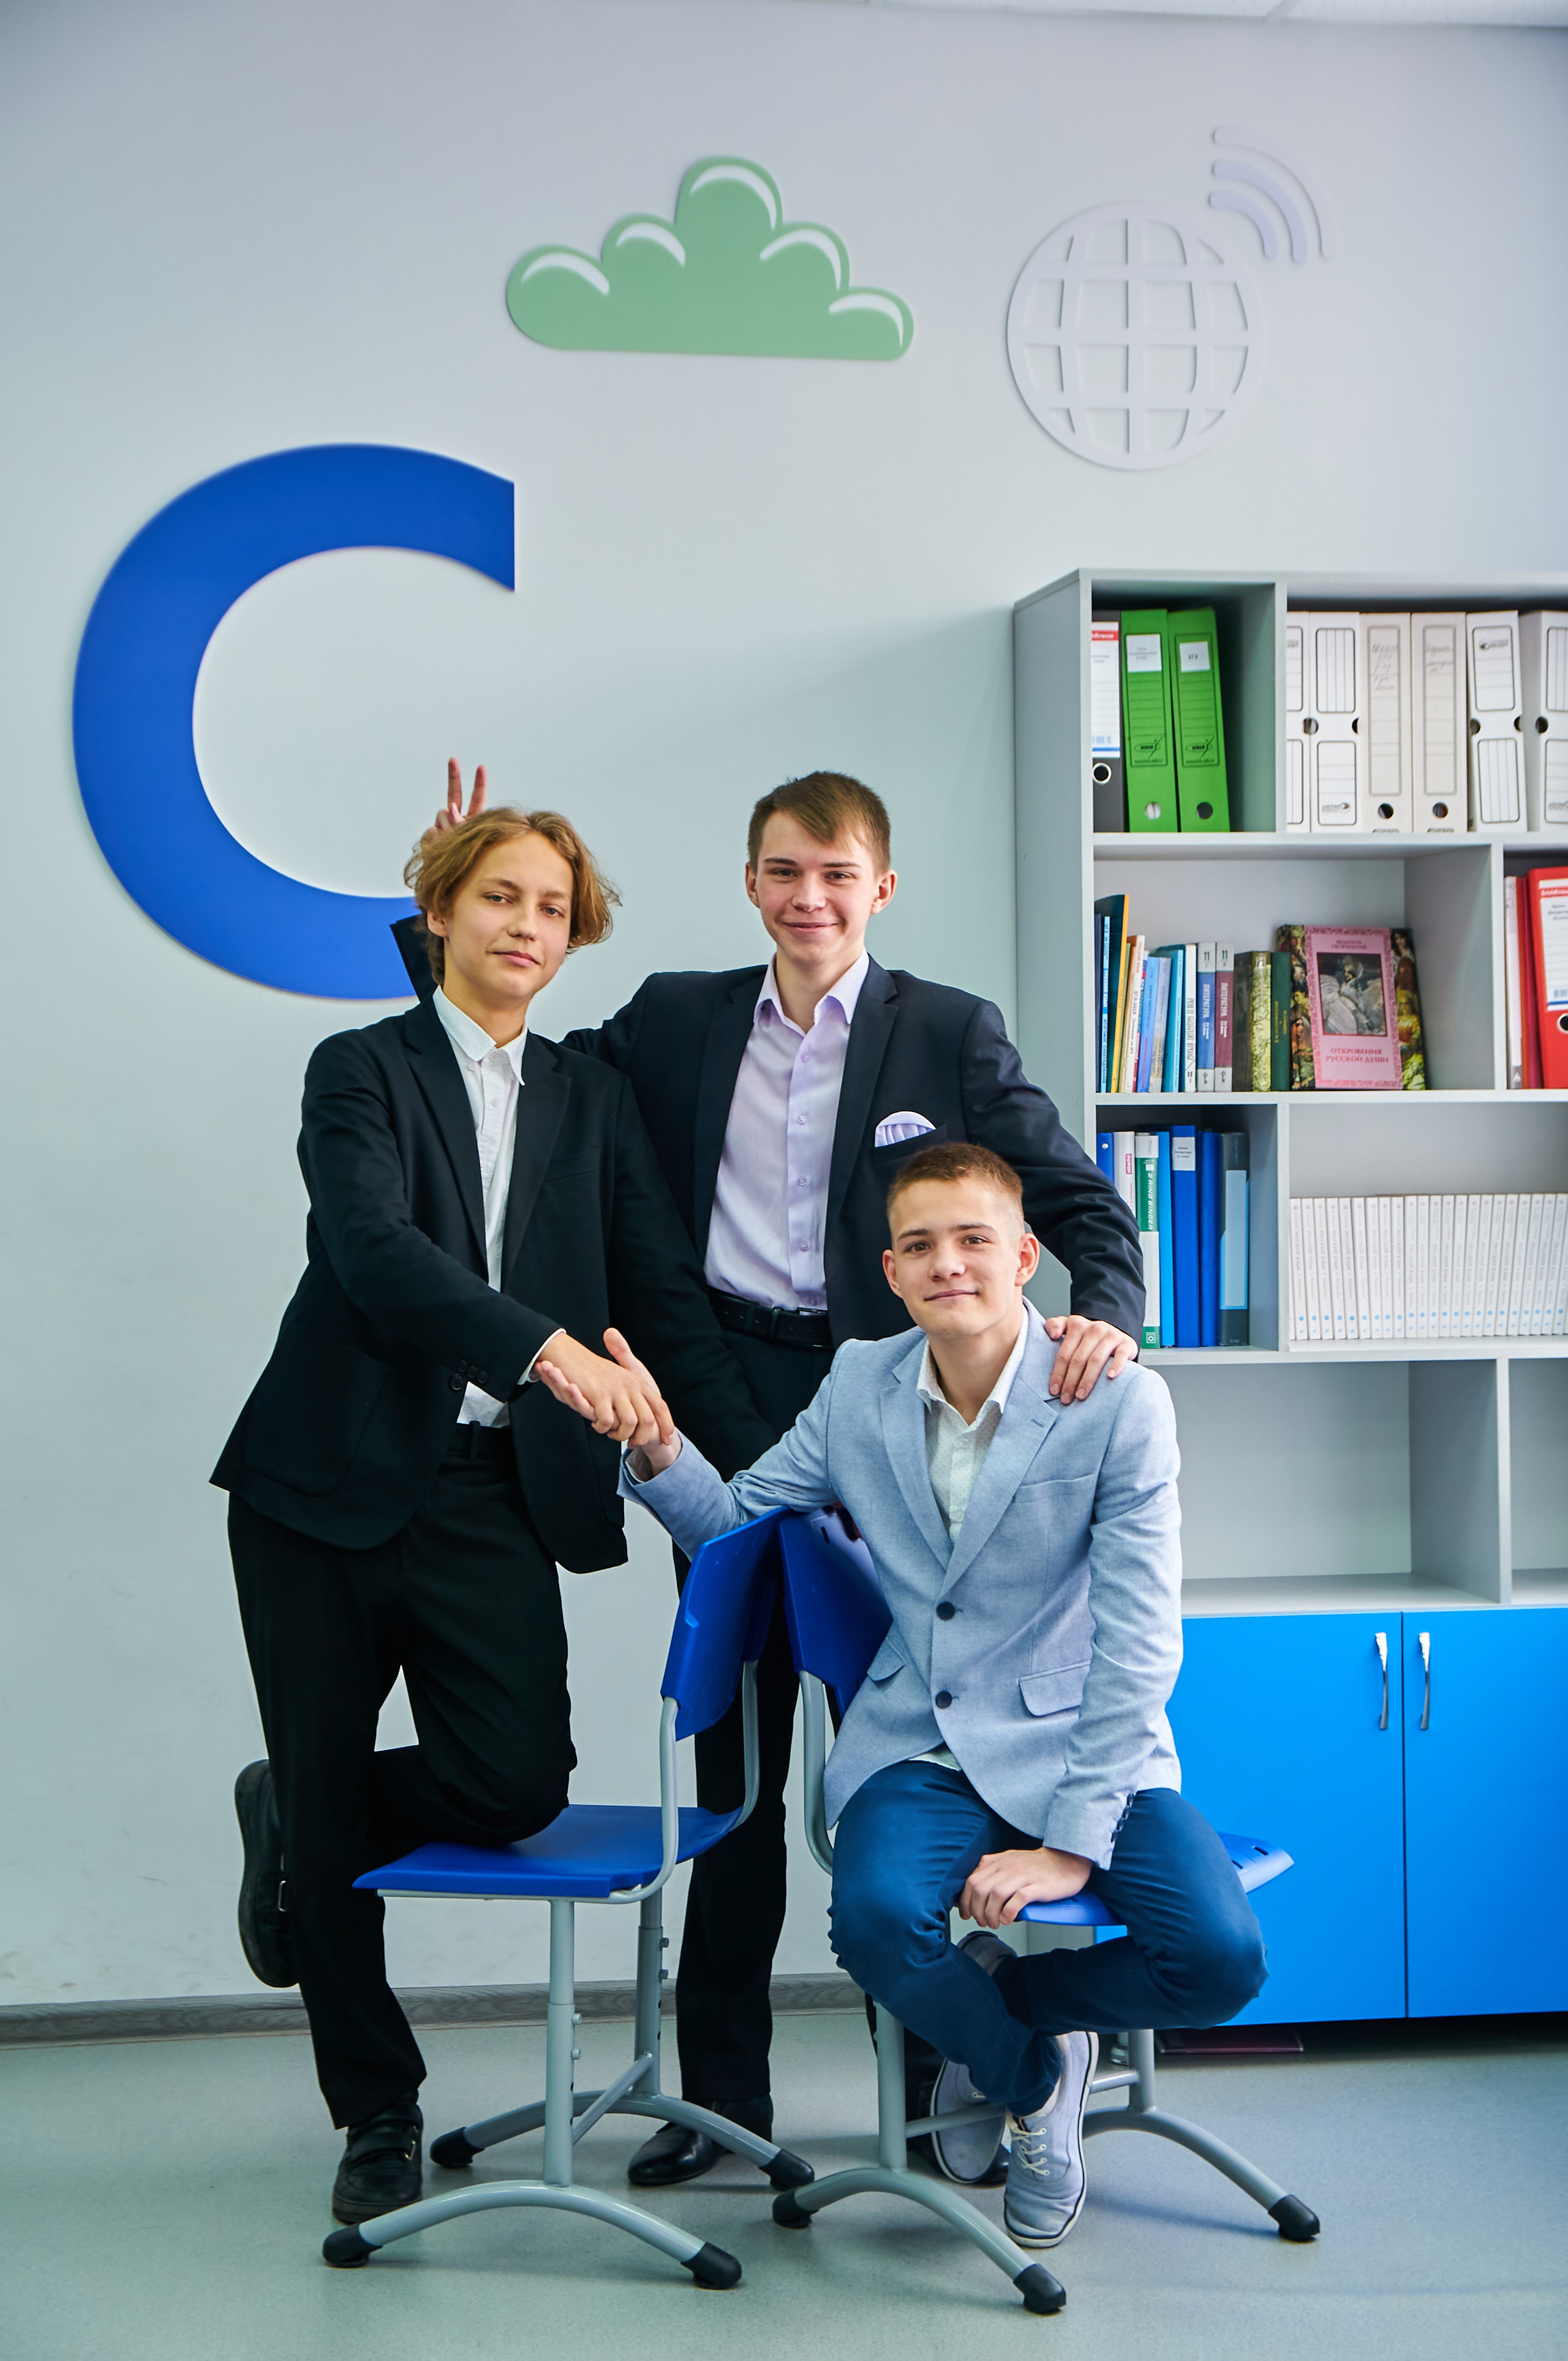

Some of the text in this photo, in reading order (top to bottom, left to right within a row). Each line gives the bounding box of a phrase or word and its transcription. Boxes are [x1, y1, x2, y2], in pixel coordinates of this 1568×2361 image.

[72, 442, 514, 1000] C
[1204, 951, 1210, 961] 11
[1222, 950, 1228, 959] 11
